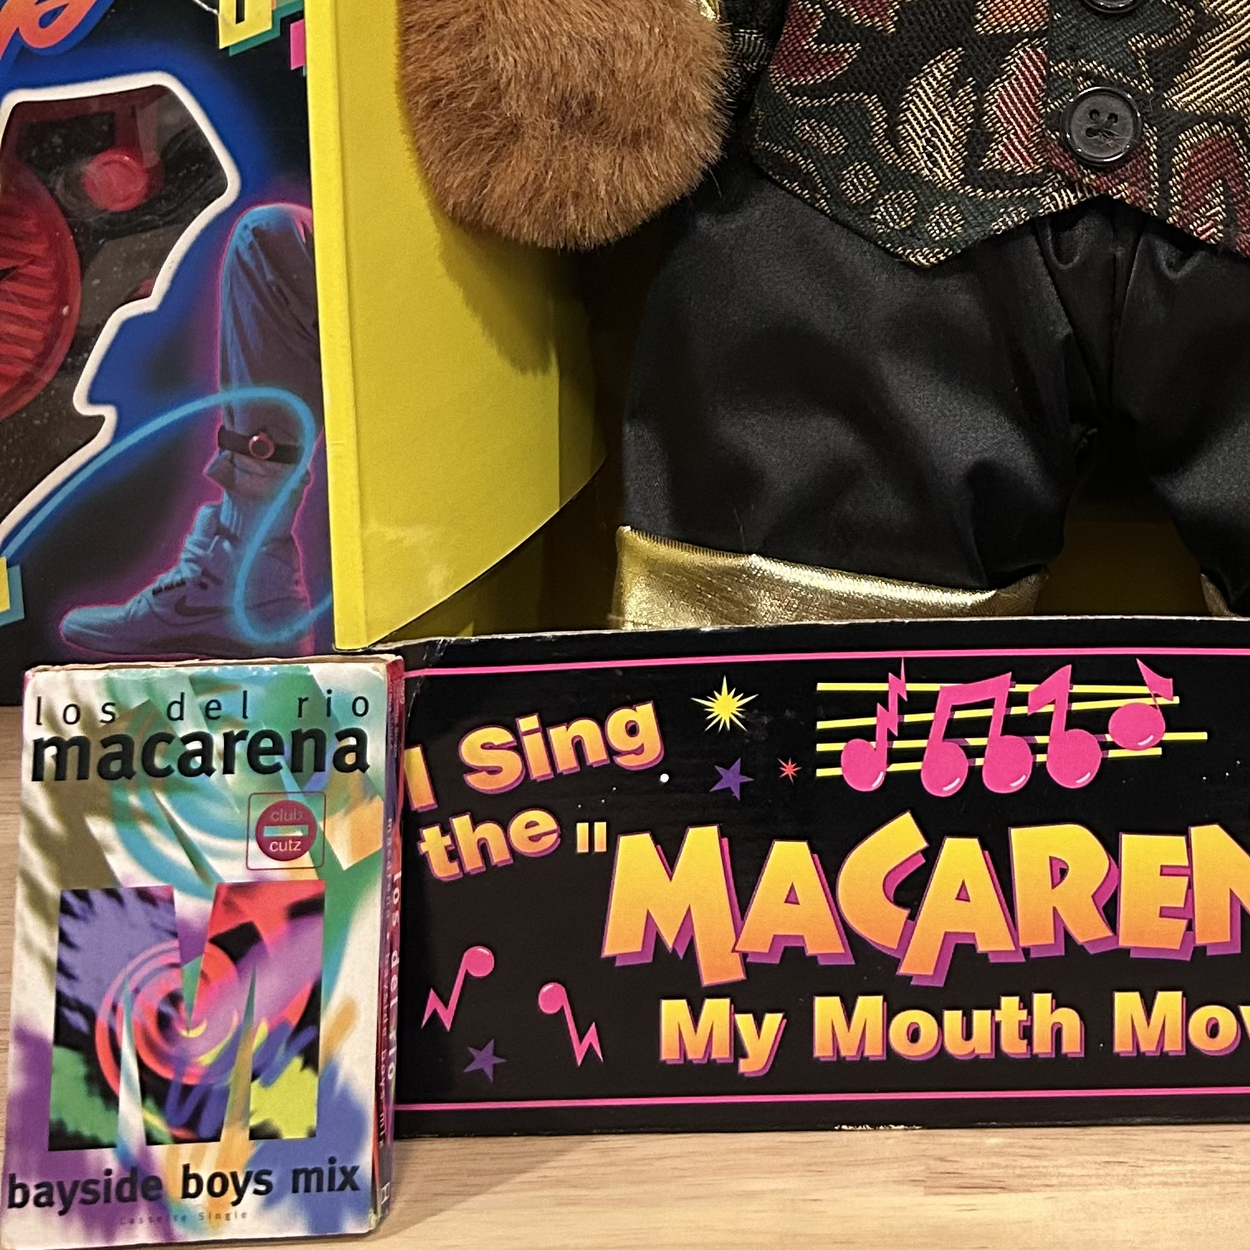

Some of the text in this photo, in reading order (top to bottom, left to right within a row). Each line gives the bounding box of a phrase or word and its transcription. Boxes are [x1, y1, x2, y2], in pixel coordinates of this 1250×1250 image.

[35, 696, 116, 725] los
[166, 692, 247, 721] del
[297, 689, 370, 718] rio
[31, 726, 371, 782] macarena
[403, 744, 438, 812] I
[458, 701, 665, 794] Sing
[271, 808, 302, 822] club
[269, 838, 301, 852] cutz
[417, 807, 561, 881] the
[391, 871, 402, 927] los
[389, 950, 400, 1008] del
[660, 997, 787, 1078] My
[813, 990, 1084, 1063] Mouth
[7, 1156, 361, 1215] bayside boys mix
